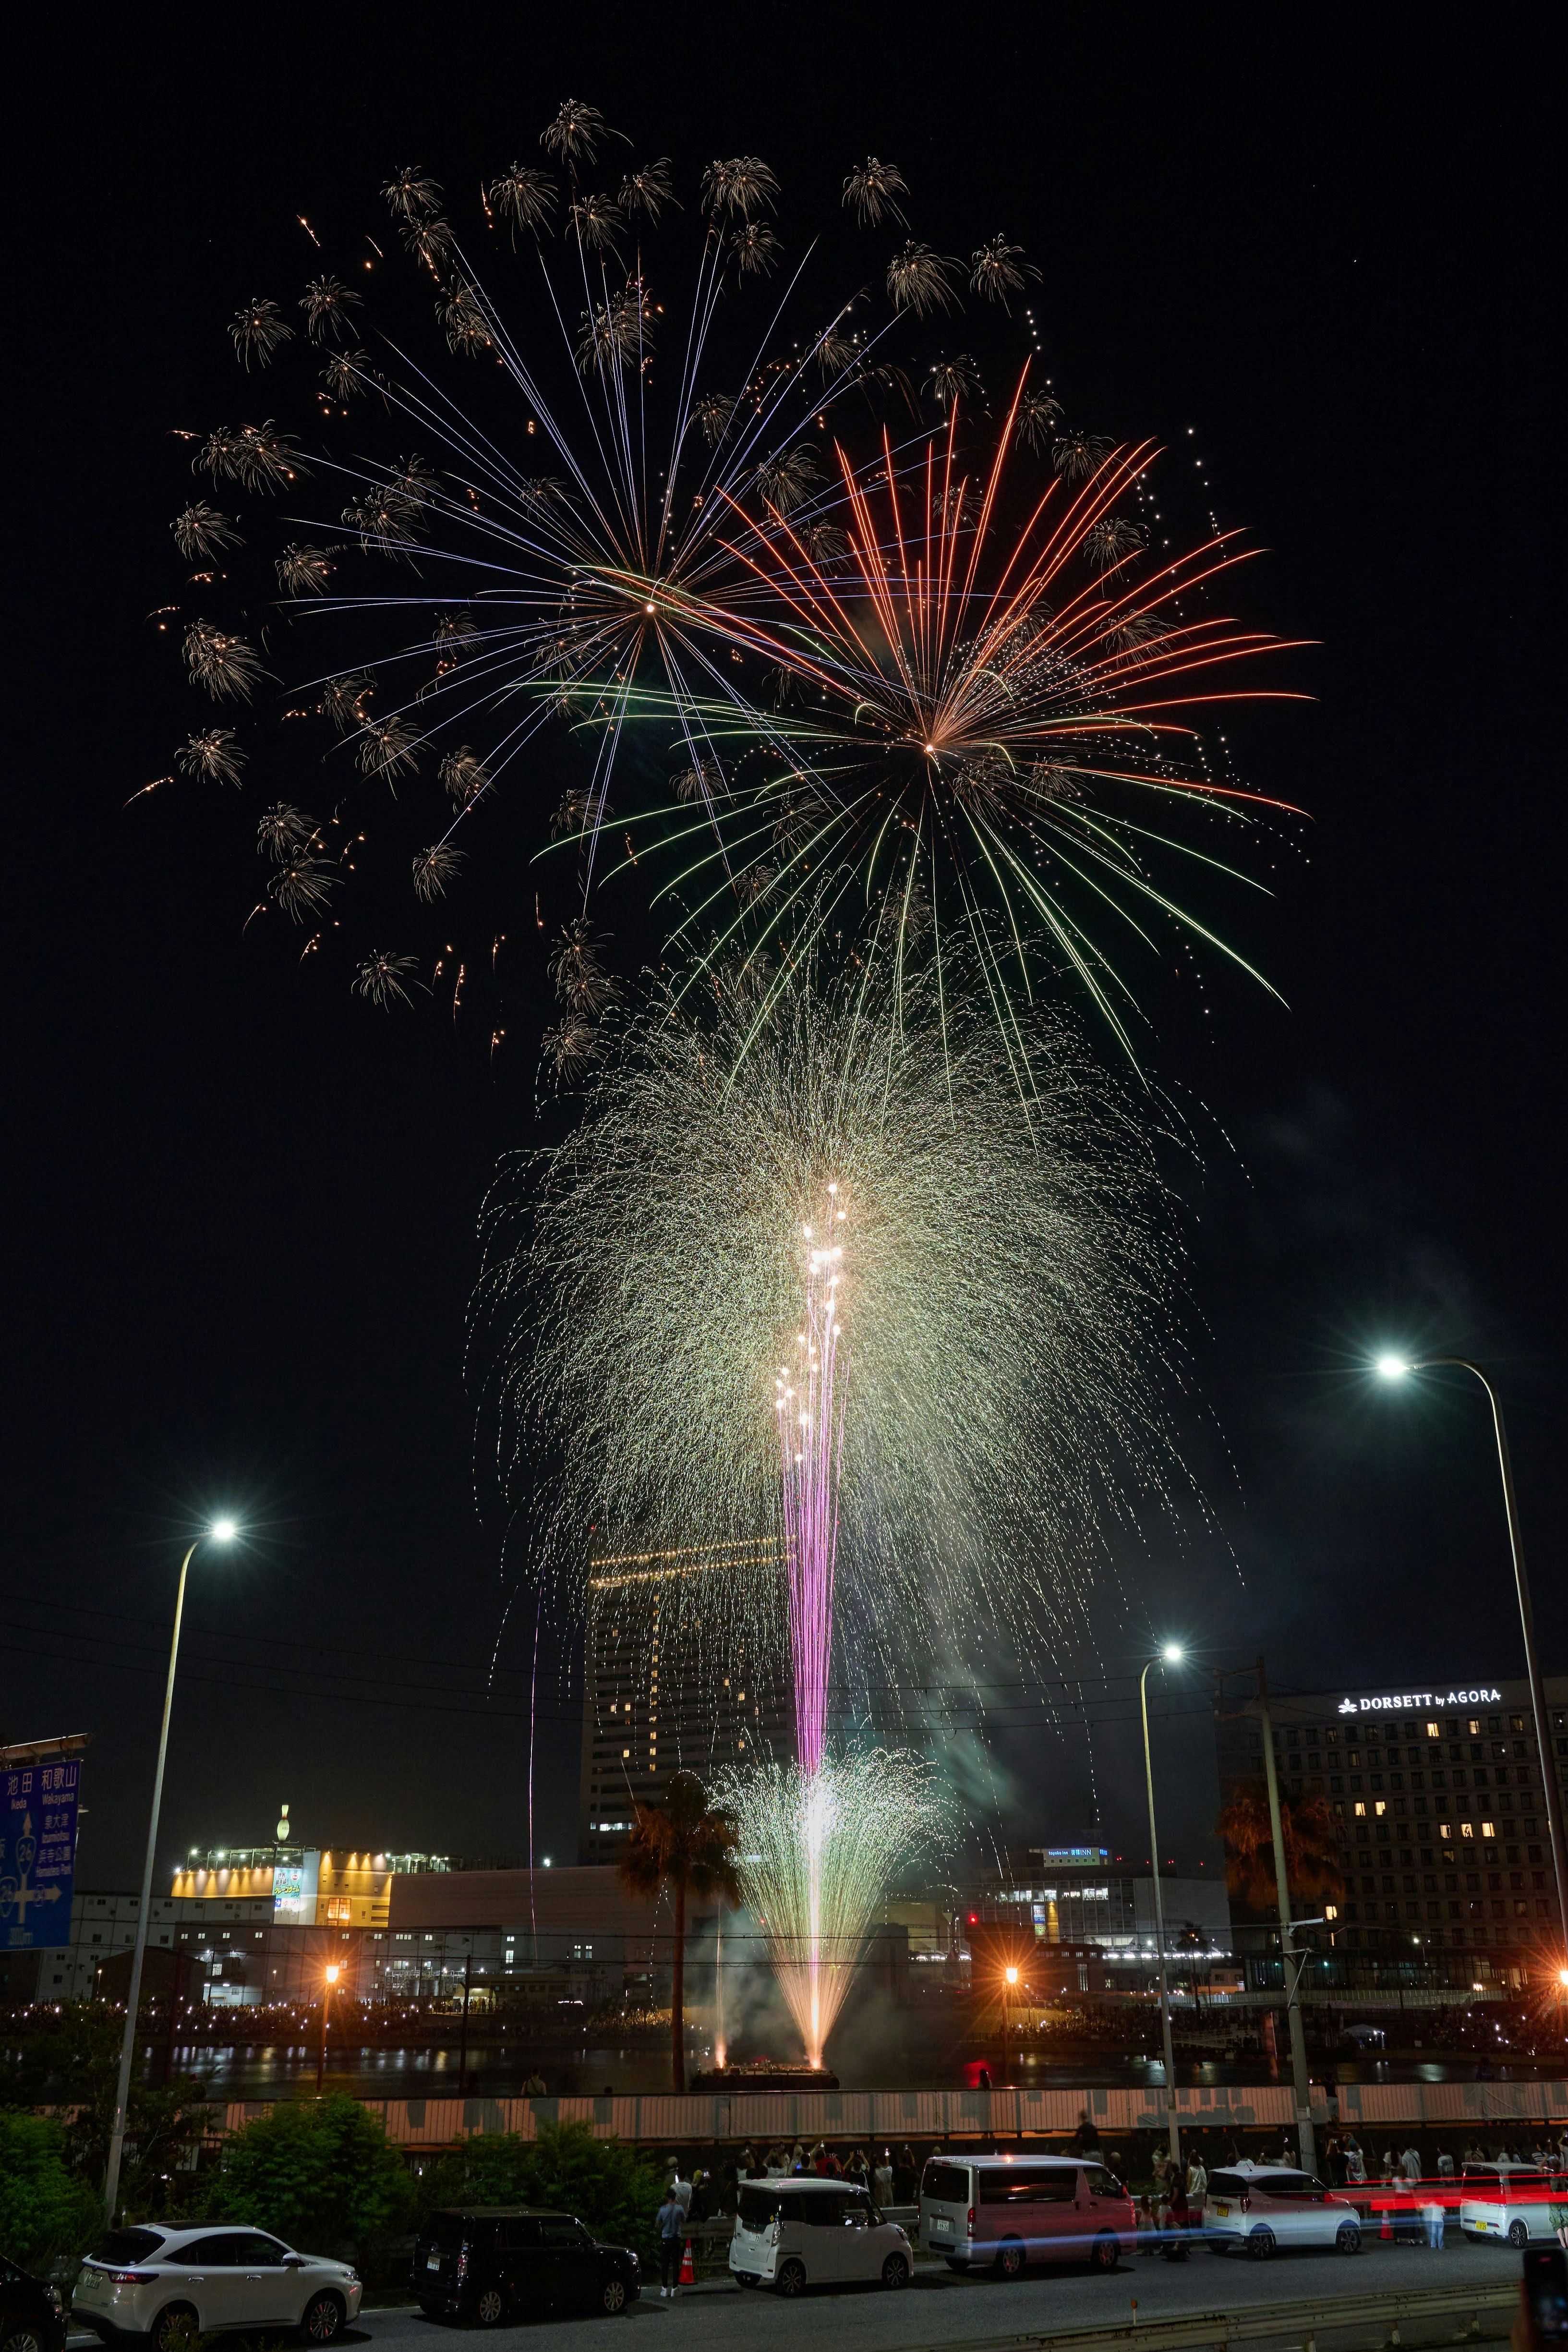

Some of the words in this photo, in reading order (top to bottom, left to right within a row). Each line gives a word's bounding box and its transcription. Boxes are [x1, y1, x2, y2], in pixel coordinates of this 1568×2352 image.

[1360, 1694, 1432, 1710] DORSETT
[1435, 1696, 1445, 1707] by
[1447, 1689, 1501, 1704] AGORA
[7, 1772, 33, 1795] 池田
[41, 1766, 77, 1791] 和歌山
[11, 1798, 27, 1810] Ikeda
[42, 1793, 74, 1806] Wakayama
[19, 1843, 32, 1862] 26
